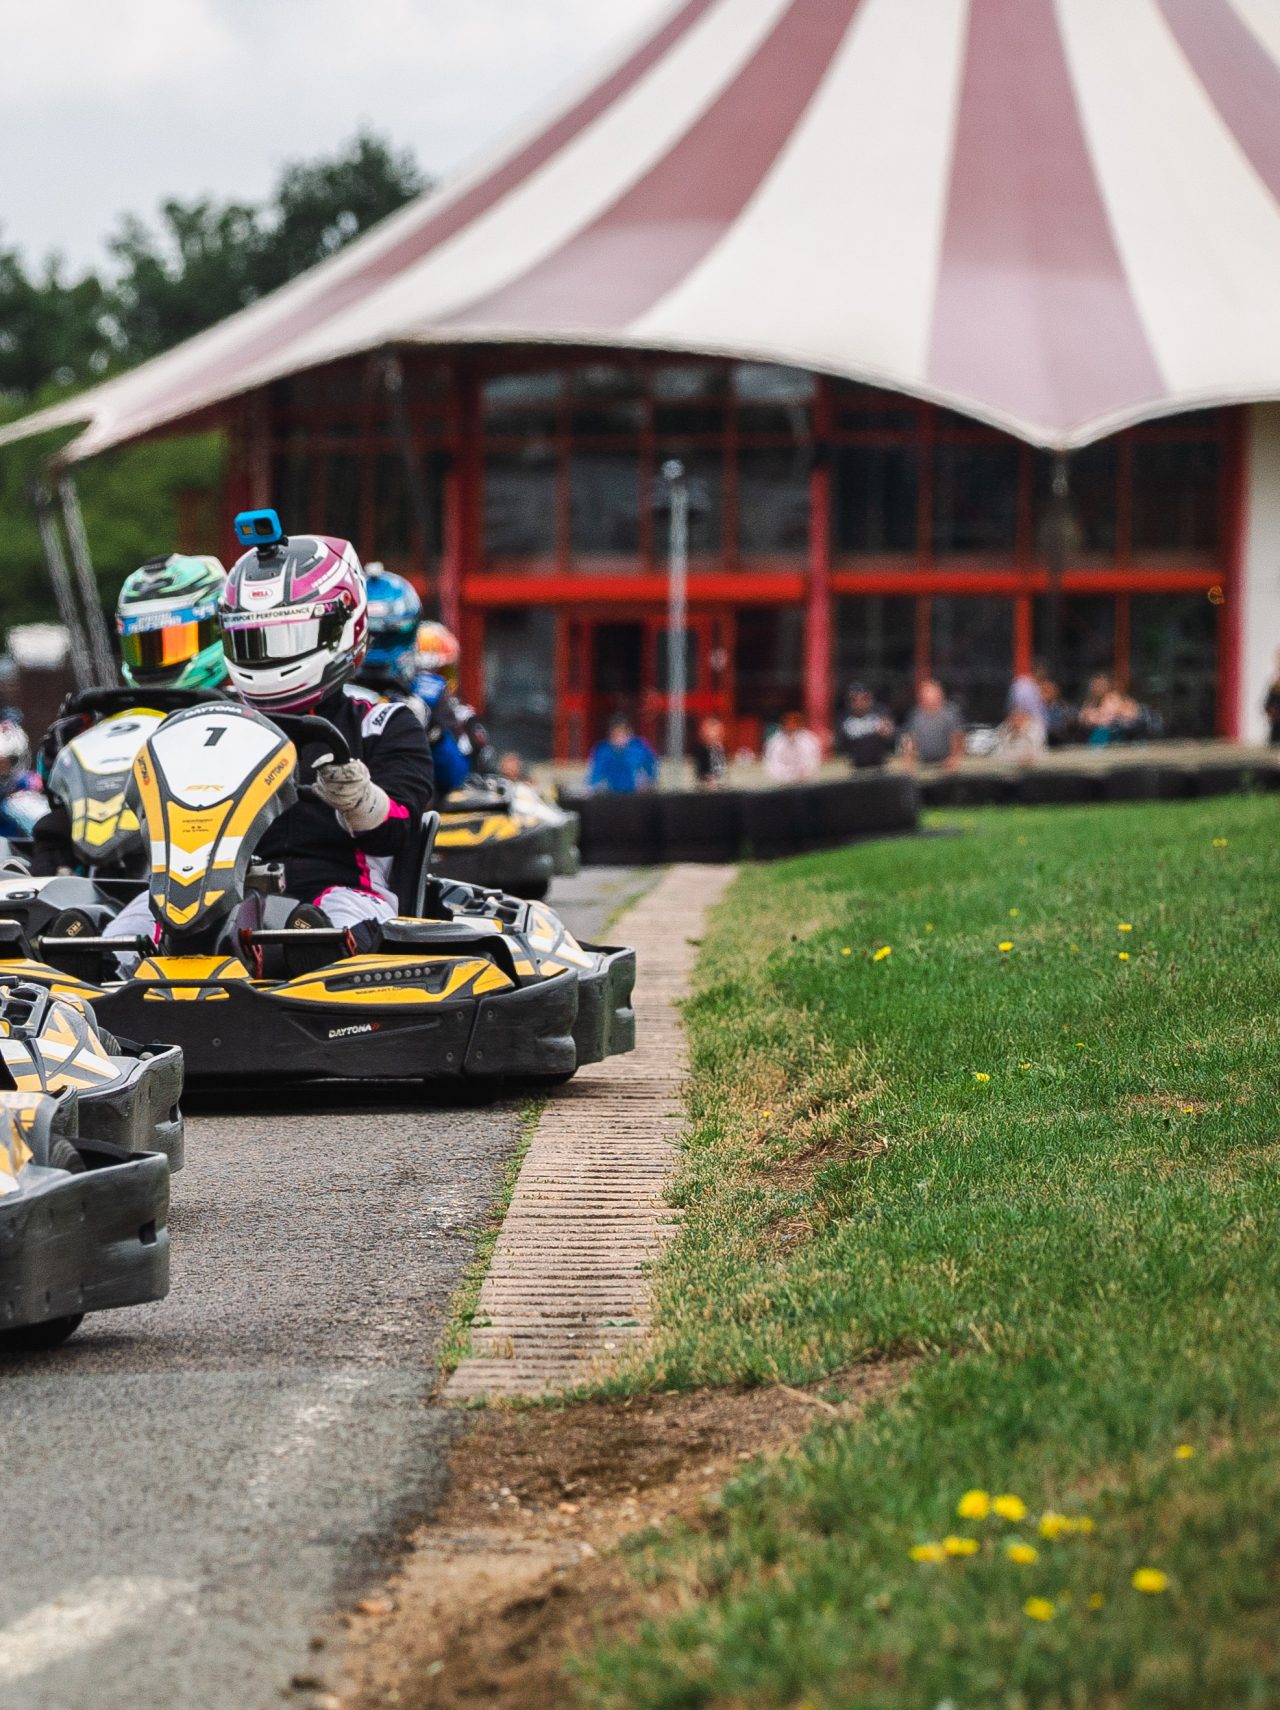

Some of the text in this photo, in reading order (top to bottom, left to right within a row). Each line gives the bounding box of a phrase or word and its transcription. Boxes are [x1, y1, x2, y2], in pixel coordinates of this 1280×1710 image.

[255, 607, 310, 619] PERFORMANCE
[203, 727, 228, 747] 1
[328, 1024, 372, 1038] DAYTONA
